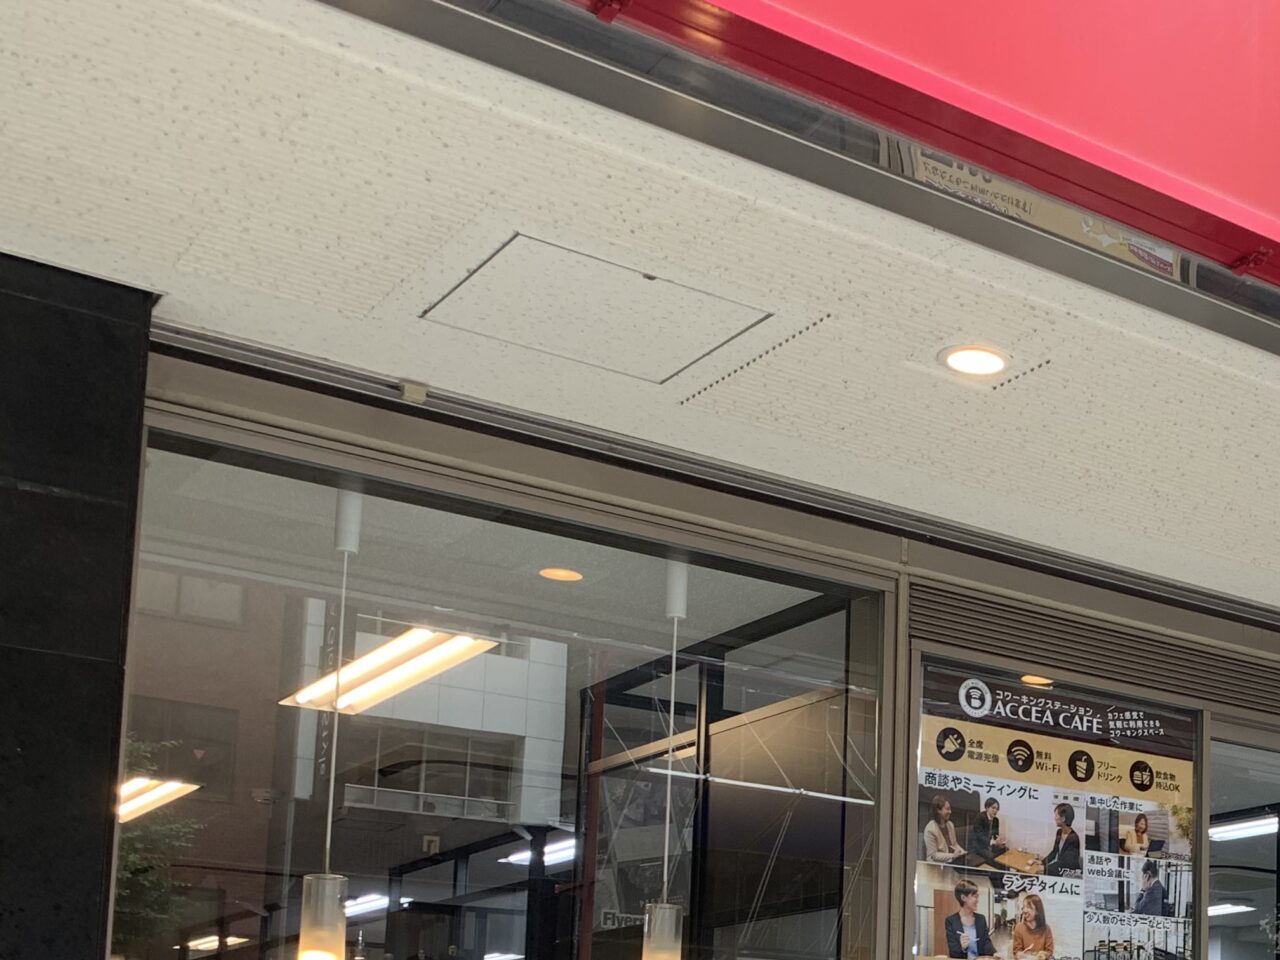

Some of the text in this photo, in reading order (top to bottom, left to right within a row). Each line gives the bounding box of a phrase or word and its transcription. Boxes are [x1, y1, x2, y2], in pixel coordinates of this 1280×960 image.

[996, 690, 1093, 716] コワーキングステーション
[993, 701, 1054, 726] ACCEA
[968, 739, 983, 749] 全席
[1036, 751, 1051, 760] 無料
[1035, 761, 1061, 774] Wi-Fi
[1097, 761, 1116, 770] フリー
[1097, 771, 1123, 783] ドリンク
[924, 771, 1039, 800] 商談やミーティングに
[1089, 796, 1143, 811] 集中した作業に
[1002, 876, 1080, 896] ランチタイムに
